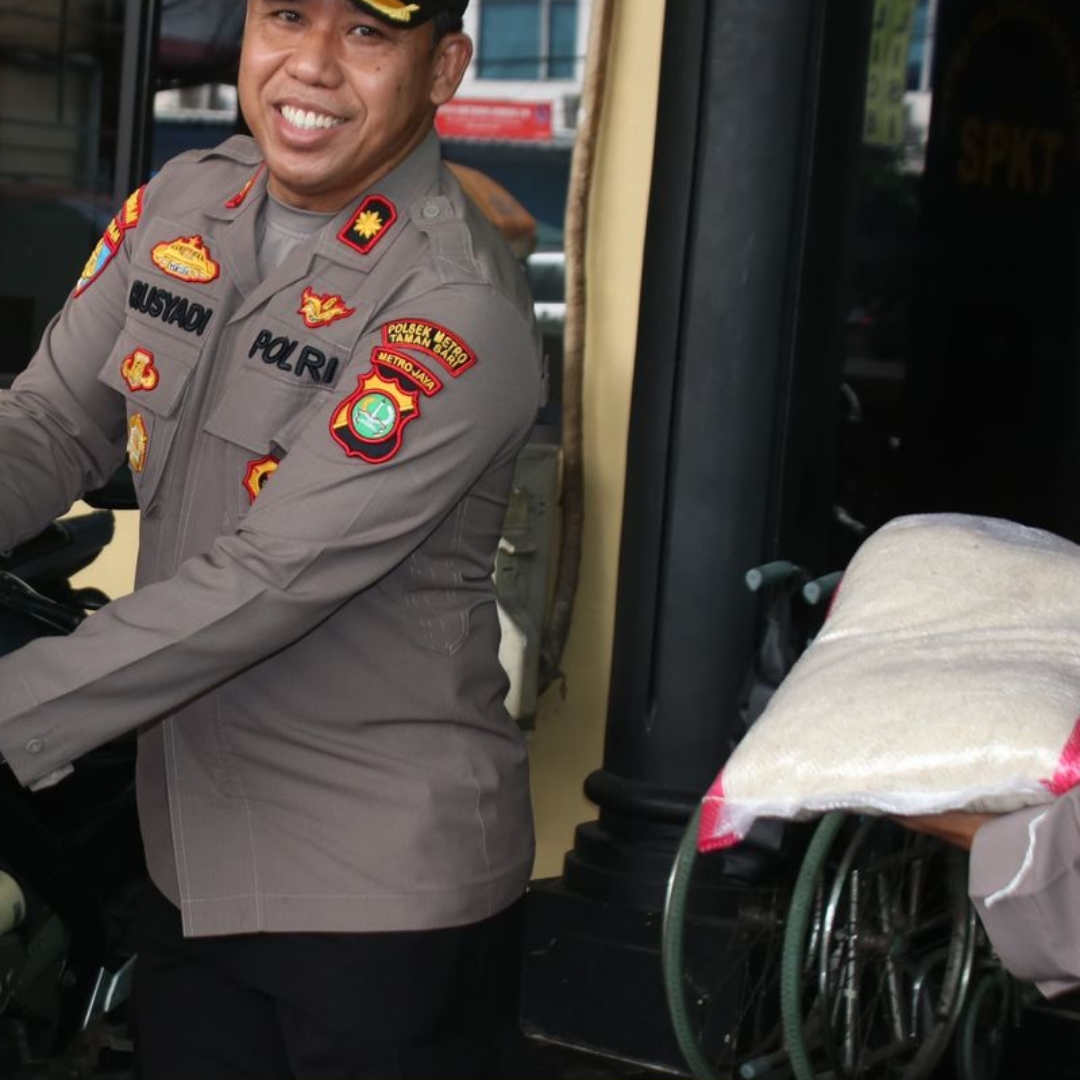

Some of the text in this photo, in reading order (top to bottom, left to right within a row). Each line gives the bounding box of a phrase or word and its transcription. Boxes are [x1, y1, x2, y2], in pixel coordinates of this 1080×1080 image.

[956, 116, 1063, 195] SPKT
[129, 280, 213, 336] RUSYADI
[248, 329, 340, 384] POLRI
[388, 323, 468, 363] POLSEK METRO
[389, 334, 460, 369] TAMAN SARI
[377, 352, 434, 391] METRO JAYA
